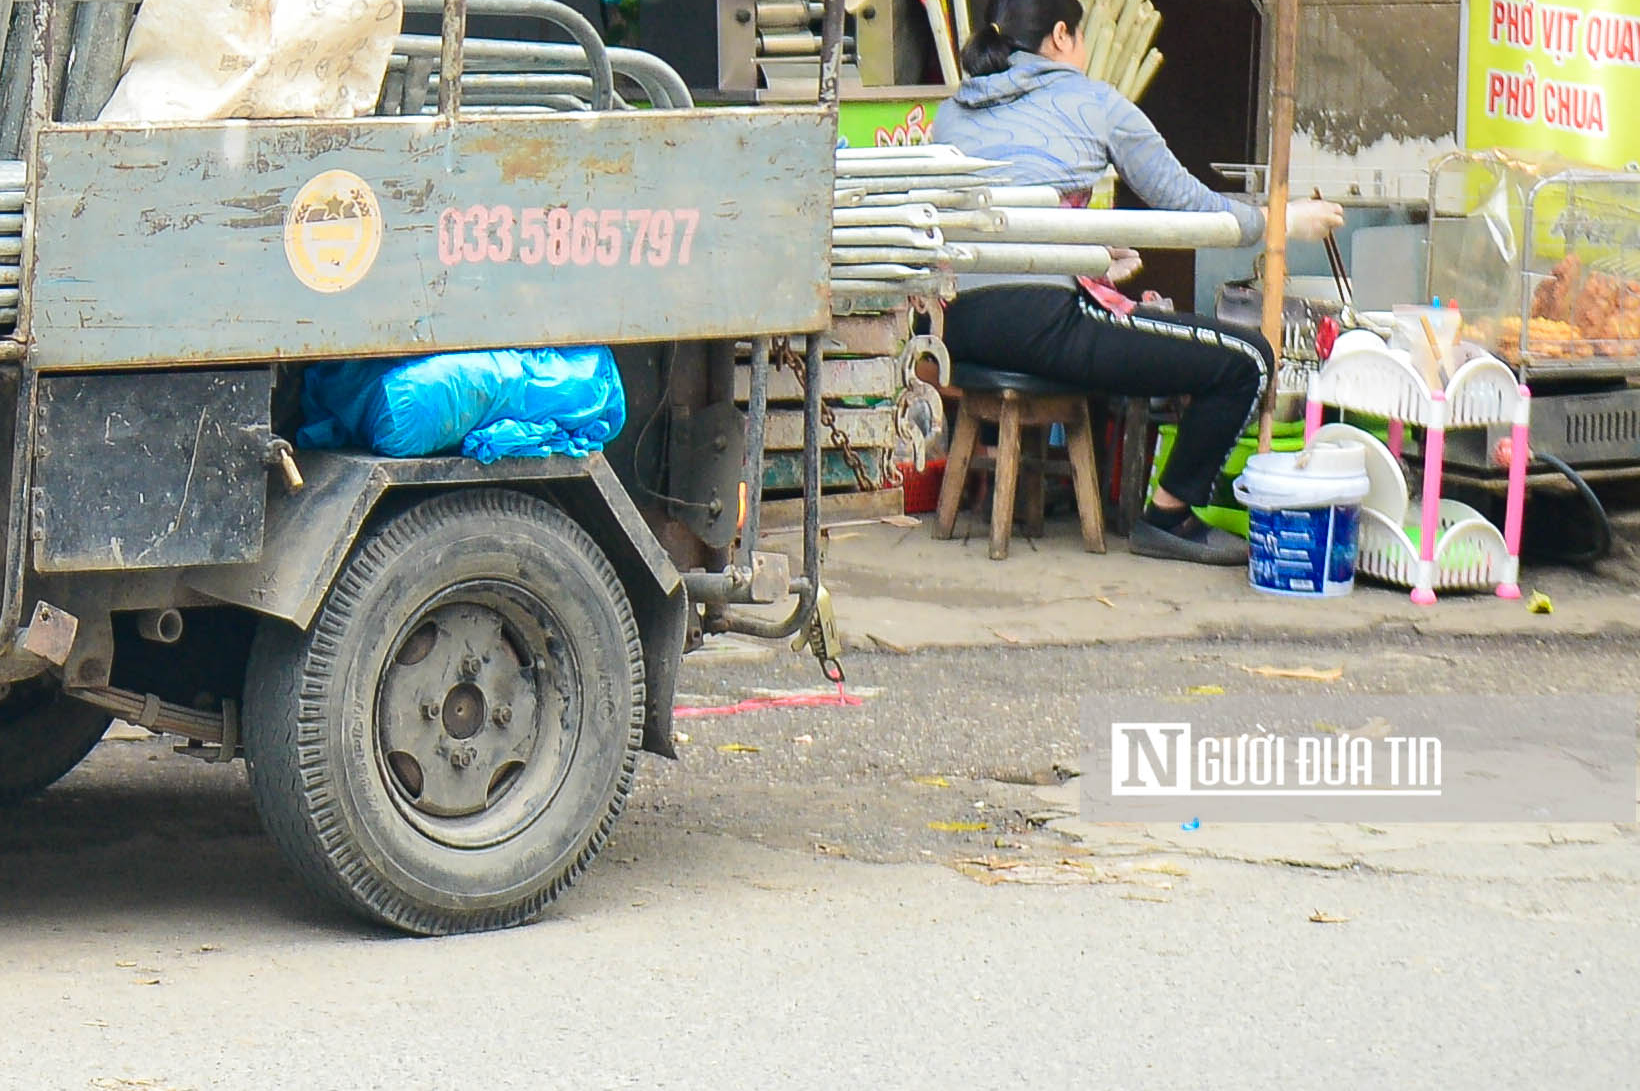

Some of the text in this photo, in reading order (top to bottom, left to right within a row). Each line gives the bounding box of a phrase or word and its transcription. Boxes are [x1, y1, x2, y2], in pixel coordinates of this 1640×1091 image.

[1541, 8, 1579, 61] VỊT
[1586, 16, 1640, 63] QUA
[1488, 63, 1604, 132] PHỞ CHUA
